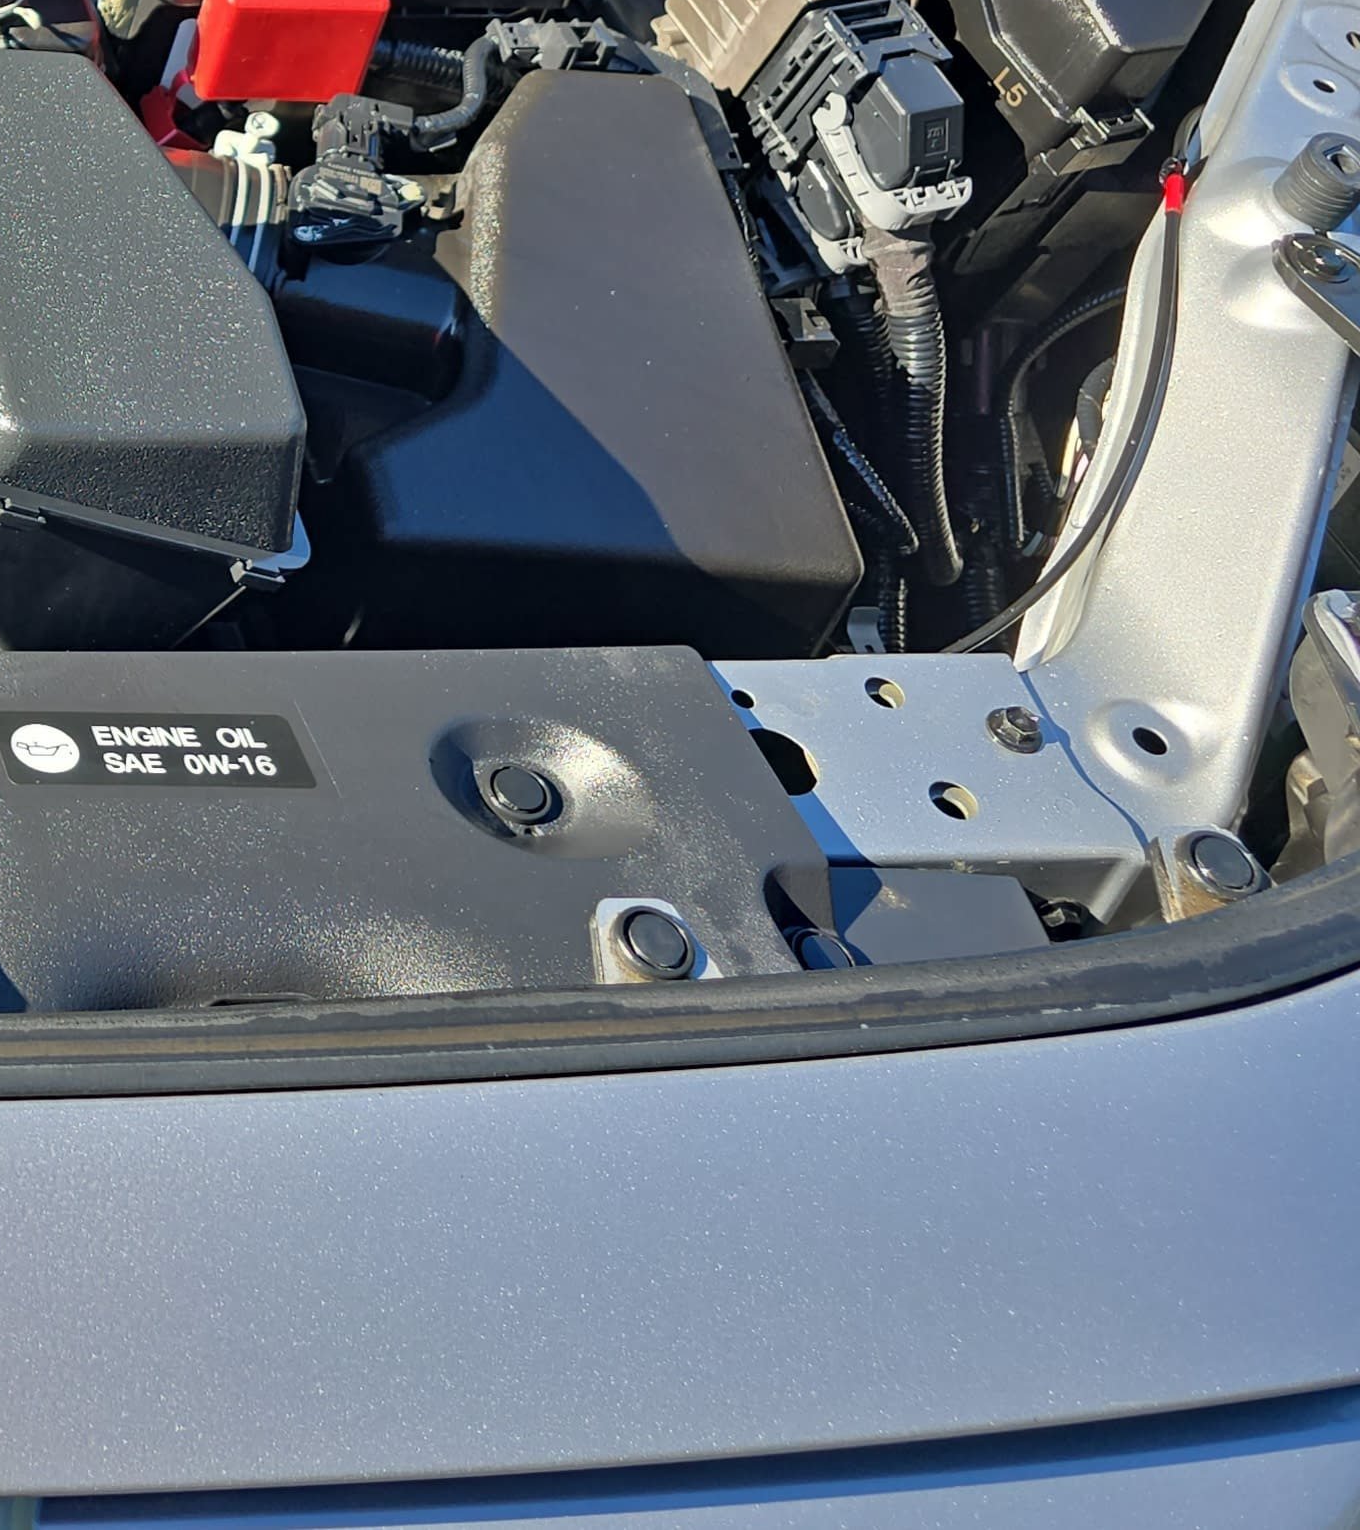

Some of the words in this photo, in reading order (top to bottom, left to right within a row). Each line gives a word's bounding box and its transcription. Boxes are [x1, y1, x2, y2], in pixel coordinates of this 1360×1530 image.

[992, 65, 1029, 108] L5
[91, 725, 202, 748] ENGINE
[216, 727, 268, 749] OIL
[103, 752, 168, 775] SAE
